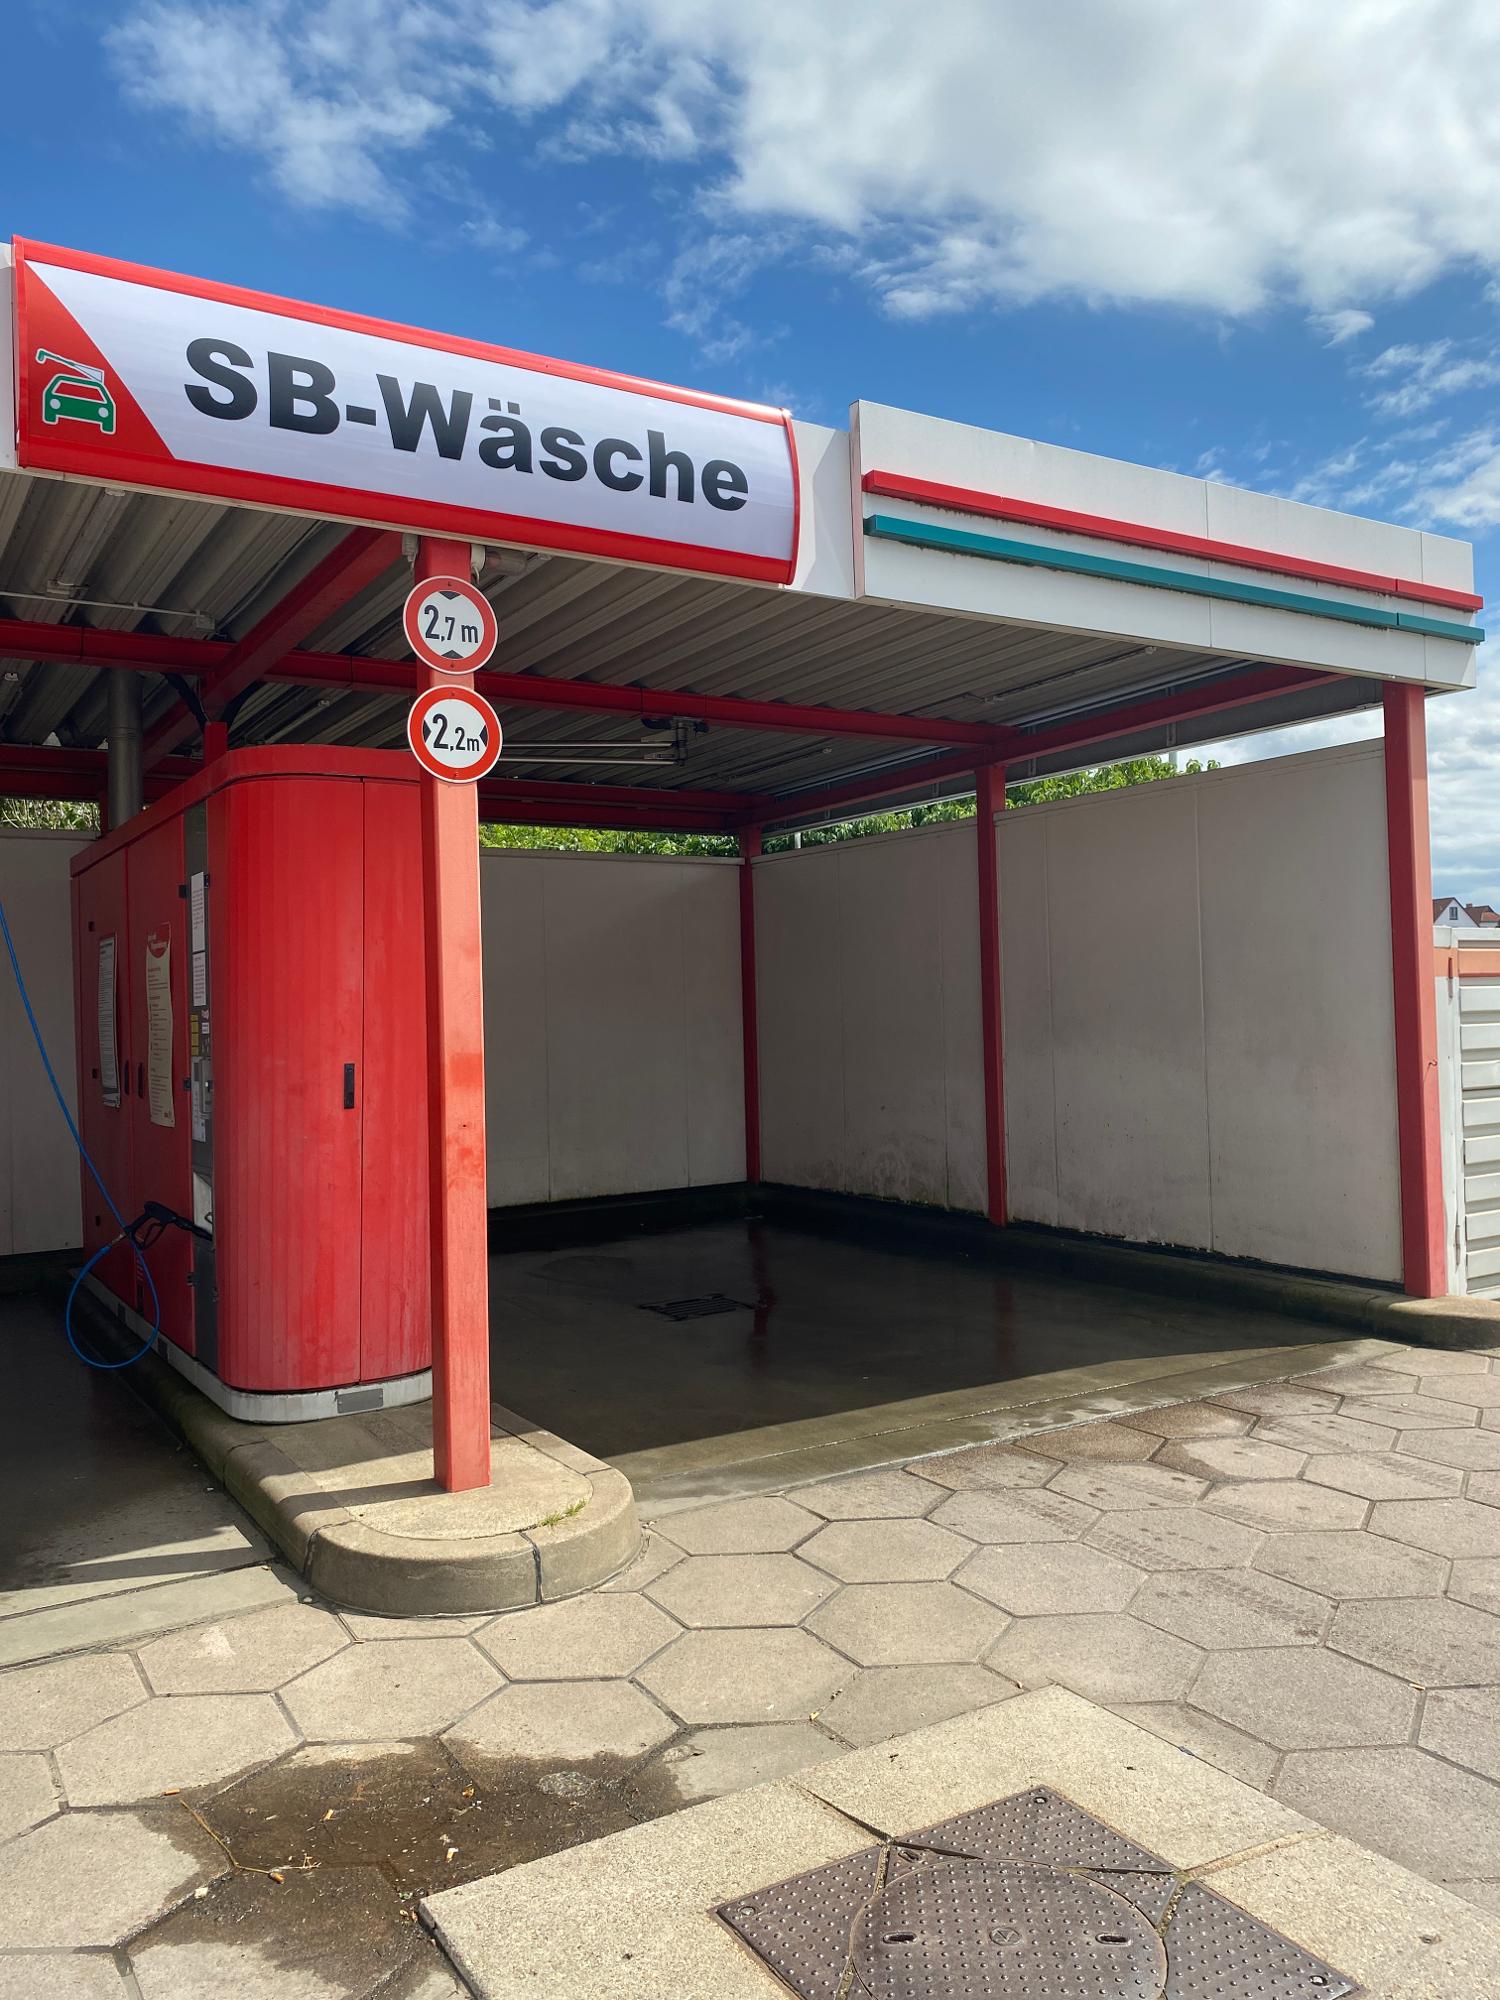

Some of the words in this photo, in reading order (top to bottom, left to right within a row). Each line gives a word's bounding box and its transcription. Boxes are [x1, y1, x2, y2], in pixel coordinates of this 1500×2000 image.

[184, 338, 749, 512] SB-Wäsche
[424, 604, 456, 642] 2,7
[461, 624, 479, 643] m
